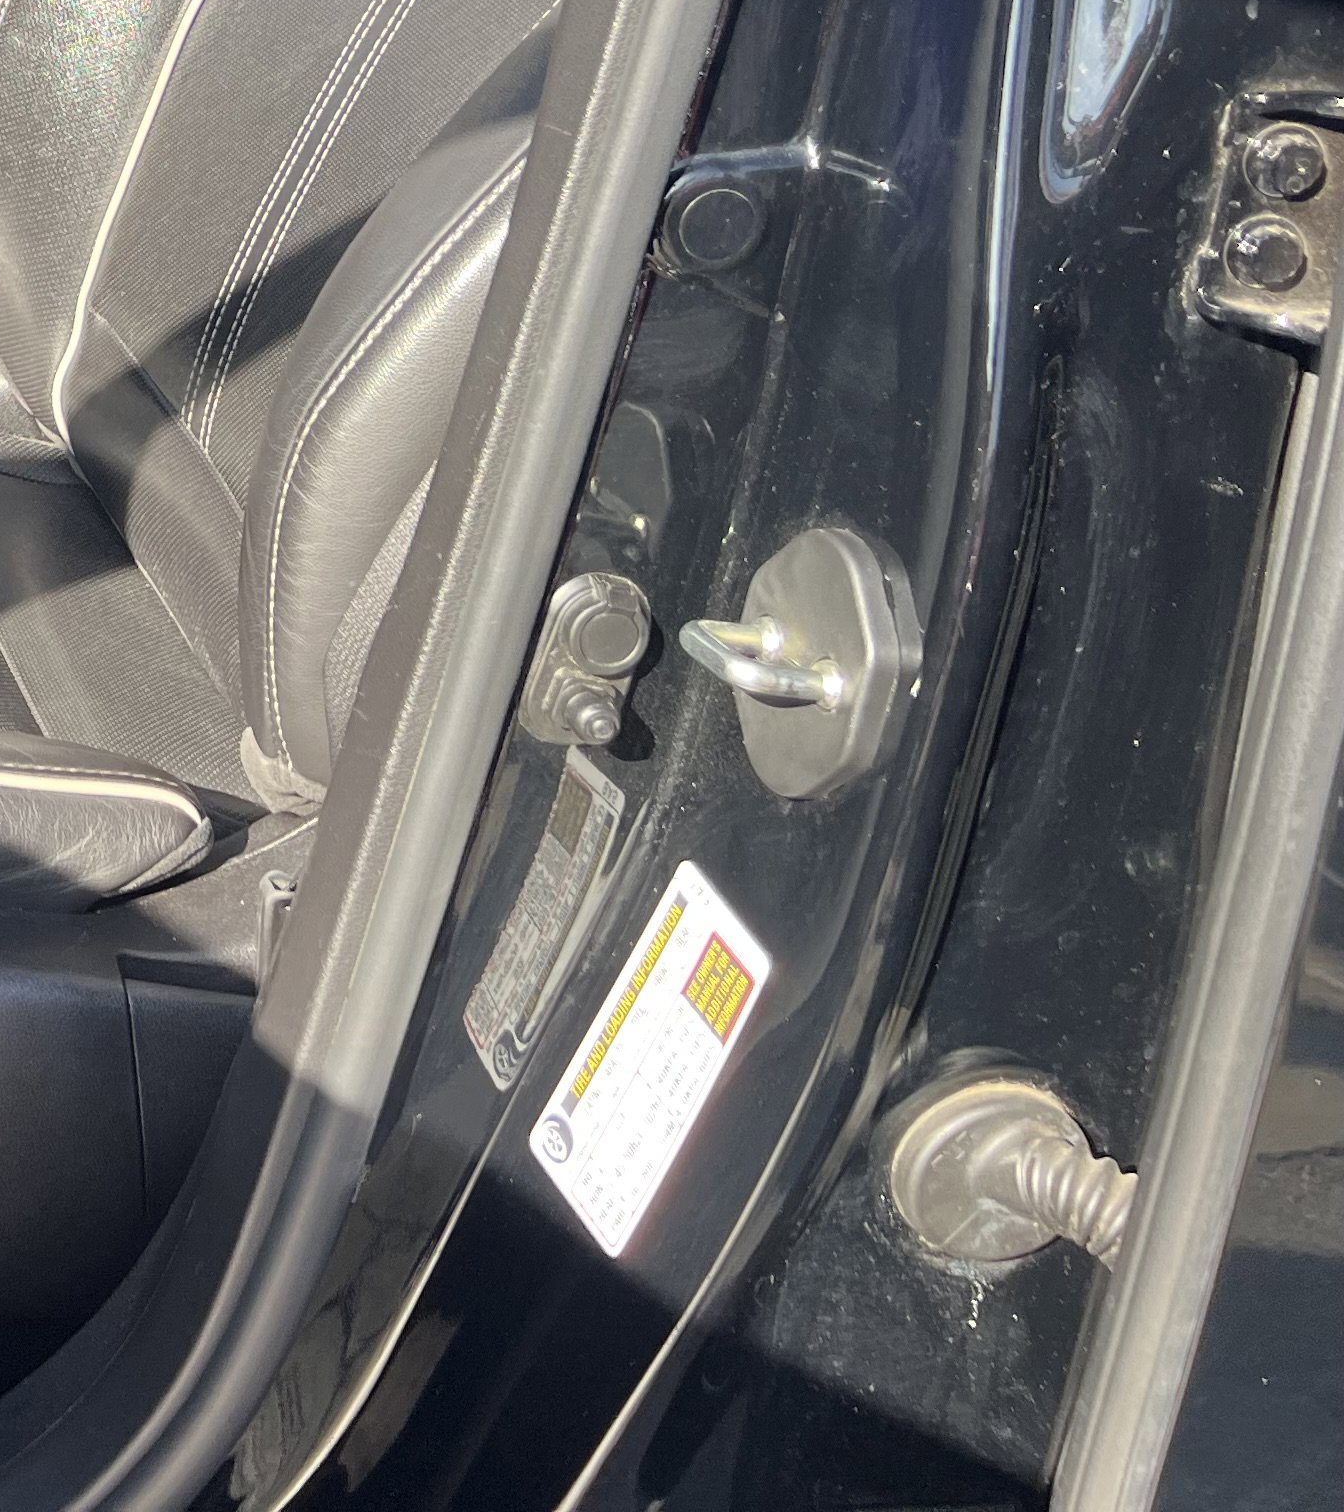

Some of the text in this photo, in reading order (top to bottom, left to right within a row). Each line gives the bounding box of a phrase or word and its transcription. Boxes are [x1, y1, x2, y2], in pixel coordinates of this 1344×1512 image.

[570, 1066, 591, 1099] TIRE
[586, 1042, 607, 1072] AND
[602, 986, 637, 1044] LOADING
[631, 903, 683, 991] INFORMATION
[686, 979, 700, 1001] SEE
[695, 950, 731, 1014] MANUAL FOR
[705, 964, 740, 1025] ADDITIONAL
[714, 973, 750, 1038] INFORMATION
